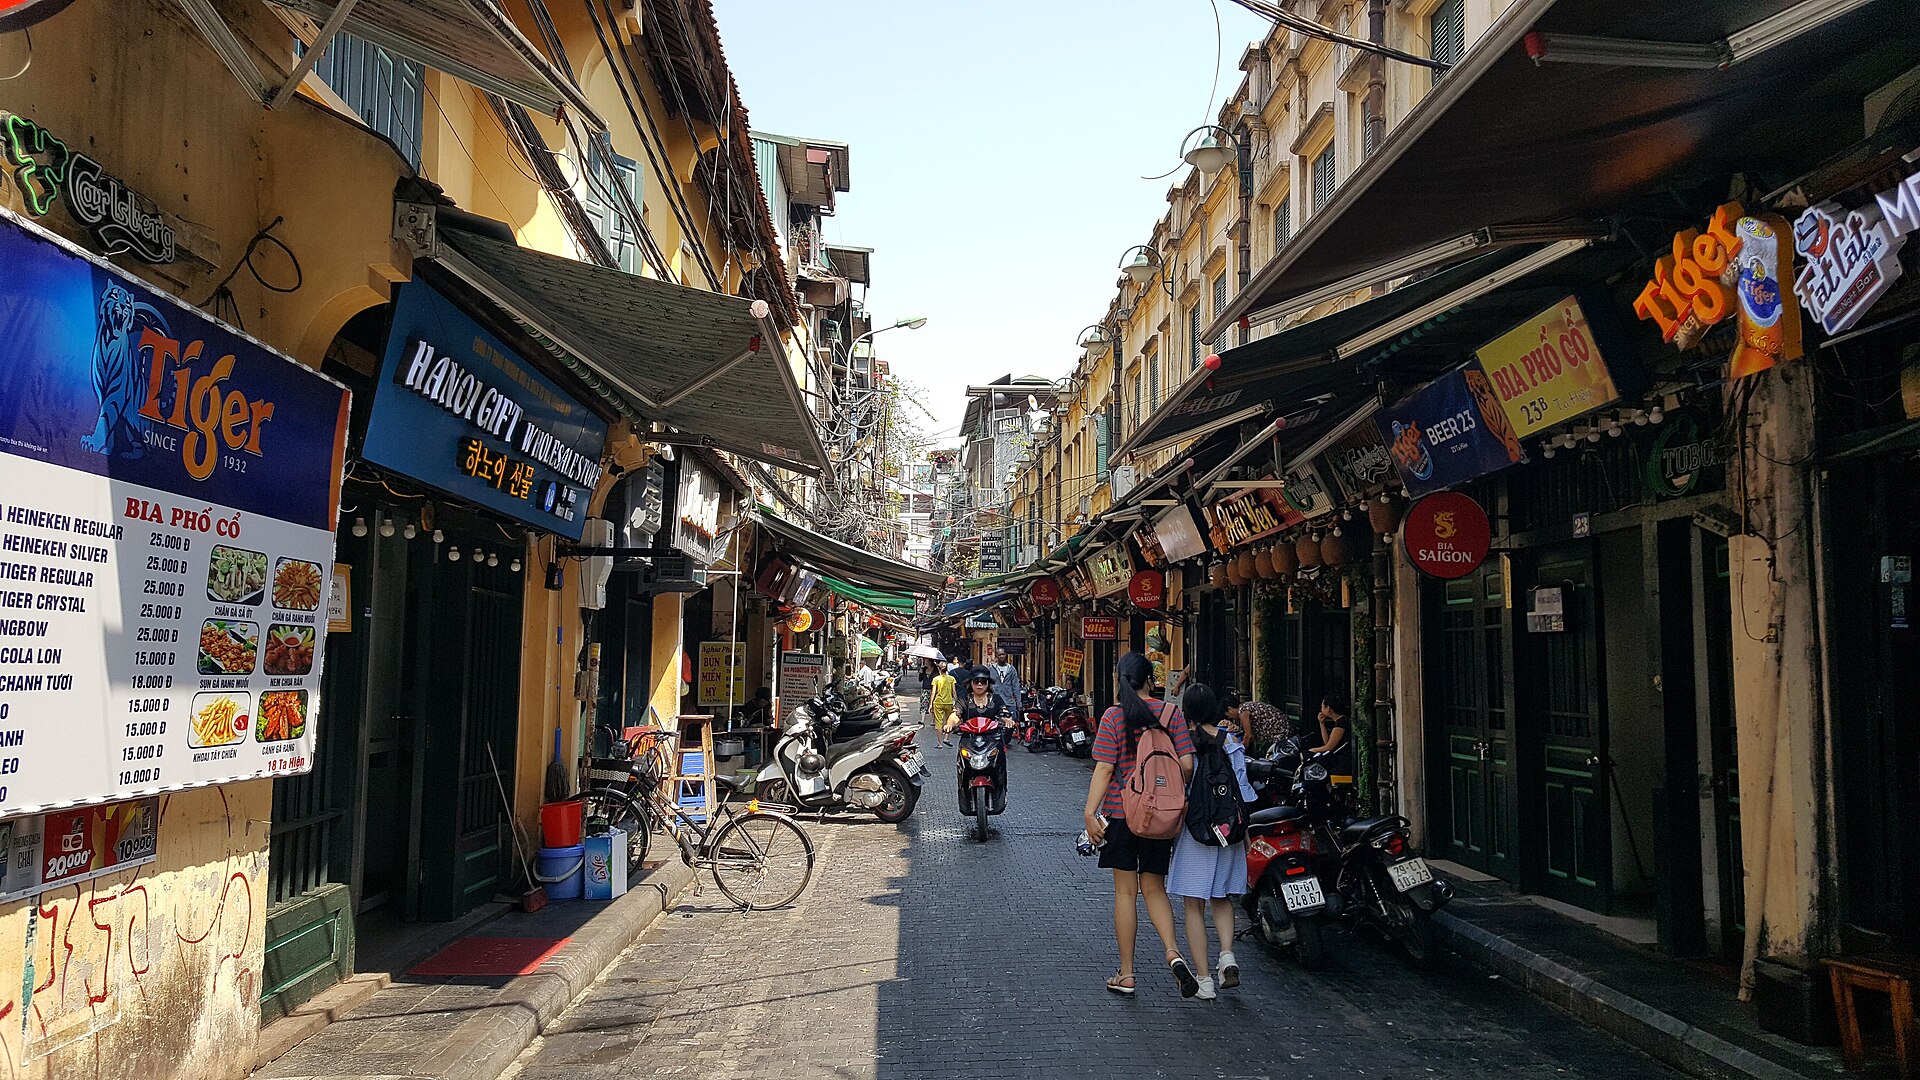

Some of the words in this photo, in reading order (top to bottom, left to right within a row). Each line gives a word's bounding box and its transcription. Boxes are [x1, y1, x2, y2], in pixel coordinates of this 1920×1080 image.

[1633, 203, 1743, 343] Tiger
[1491, 362, 1530, 401] BIA
[138, 326, 275, 481] Tiger
[477, 388, 524, 442] GIFT
[1425, 417, 1462, 446] BEER
[1456, 410, 1476, 433] 23
[143, 430, 177, 452] SINCE
[223, 455, 248, 473] 1932
[1662, 439, 1722, 478] TUBO
[465, 439, 507, 489] 하노이
[510, 462, 535, 499] 선물
[7, 505, 71, 531] HEINEKEN
[73, 517, 124, 540] REGULAR
[150, 531, 182, 551] 25.000
[124, 497, 163, 524] BIA
[170, 506, 213, 534] PHỐ
[216, 511, 242, 540] CỔ
[3, 533, 67, 558] HEINEKEN
[70, 544, 108, 563] SILVER
[146, 555, 178, 574] 25.000
[1418, 549, 1472, 563] SAIGON
[1437, 542, 1454, 550] BIA
[0, 562, 37, 581] TIGER
[40, 566, 94, 587] REGULAR
[143, 579, 175, 597] 25.000
[36, 593, 86, 613] CRYSTAL
[140, 603, 172, 620] 25.000
[1136, 595, 1160, 603] SAIGON
[137, 627, 169, 642] 25.000
[1087, 624, 1115, 633] Olive
[1, 647, 33, 664] COLA
[37, 648, 62, 664] LON
[134, 651, 166, 666] 15.000
[46, 673, 73, 690] TƯƠI
[131, 675, 163, 689] 18.000
[128, 699, 160, 714] 15.000
[125, 722, 157, 737] 15.000
[122, 745, 154, 762] 15.000
[267, 760, 276, 771] 18
[119, 769, 151, 786] 10.000
[1287, 891, 1321, 908] 348.67
